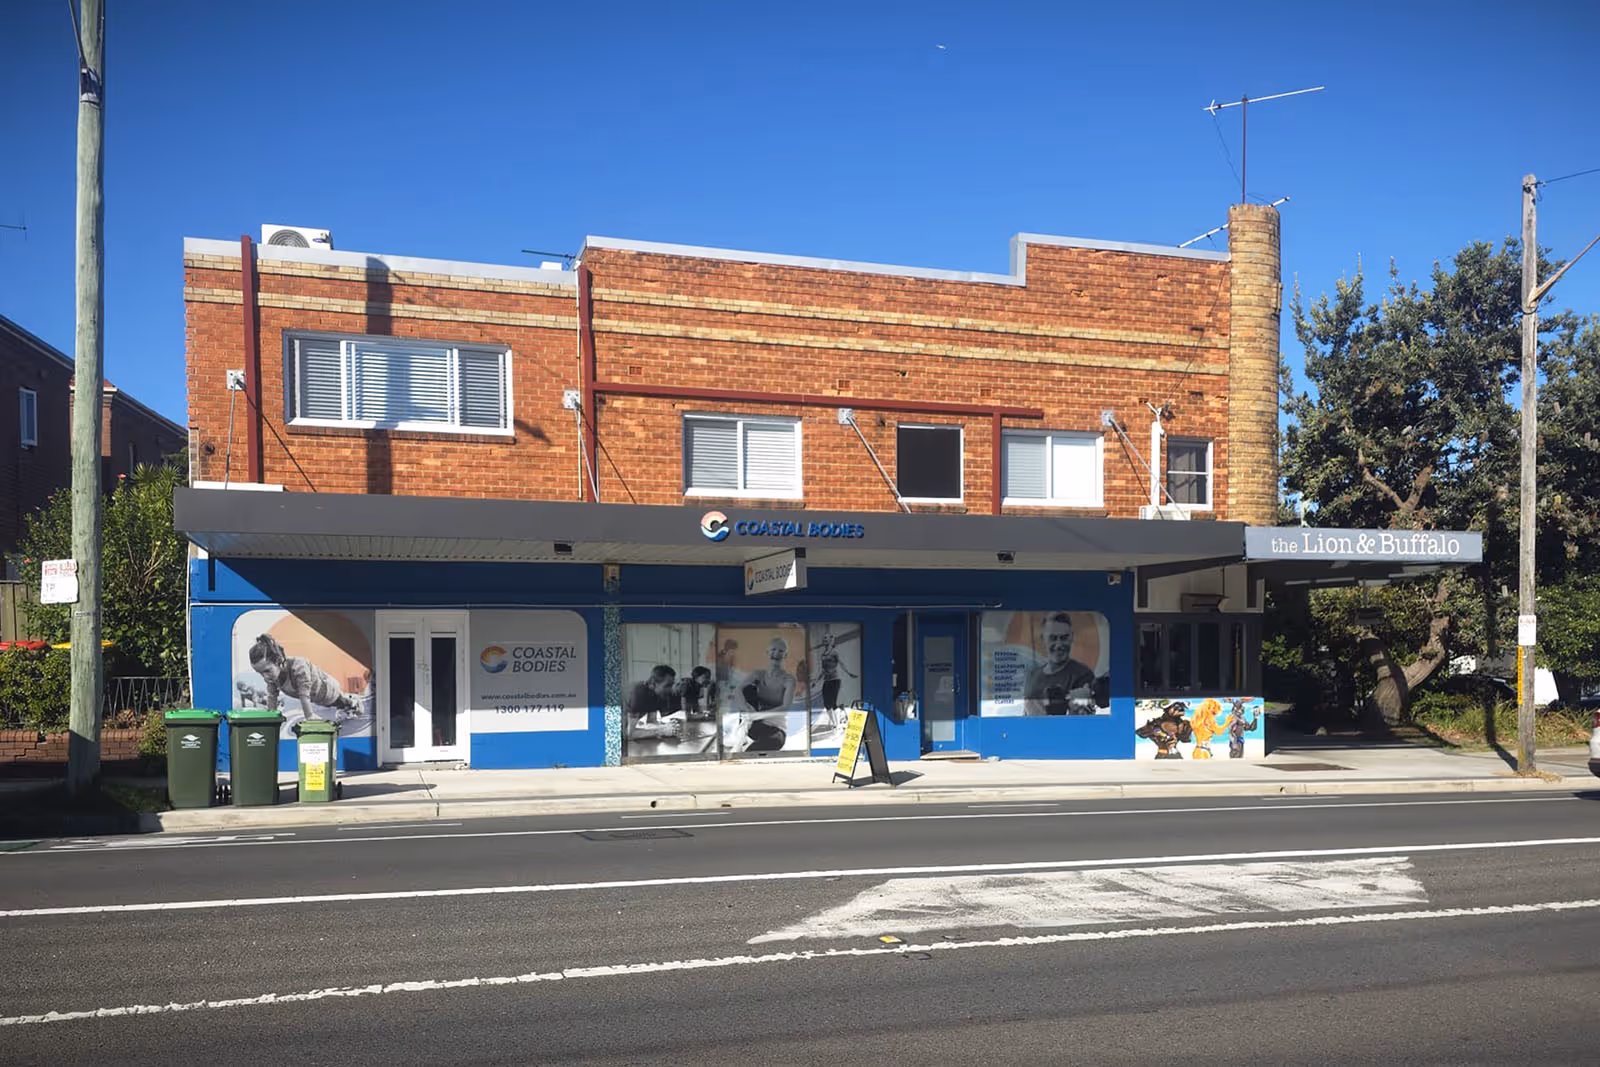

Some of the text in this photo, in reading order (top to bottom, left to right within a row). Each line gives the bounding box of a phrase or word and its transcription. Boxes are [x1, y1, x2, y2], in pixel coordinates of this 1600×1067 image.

[735, 520, 864, 538] COASTAL BODIES
[1271, 532, 1460, 556] the Lion & Buffalo
[755, 568, 775, 583] COASTAL
[512, 646, 577, 659] COASTAL
[512, 660, 566, 673] BODIES
[481, 691, 577, 701] www.coastalbodies.com.au
[495, 703, 564, 715] 1300 177 119
